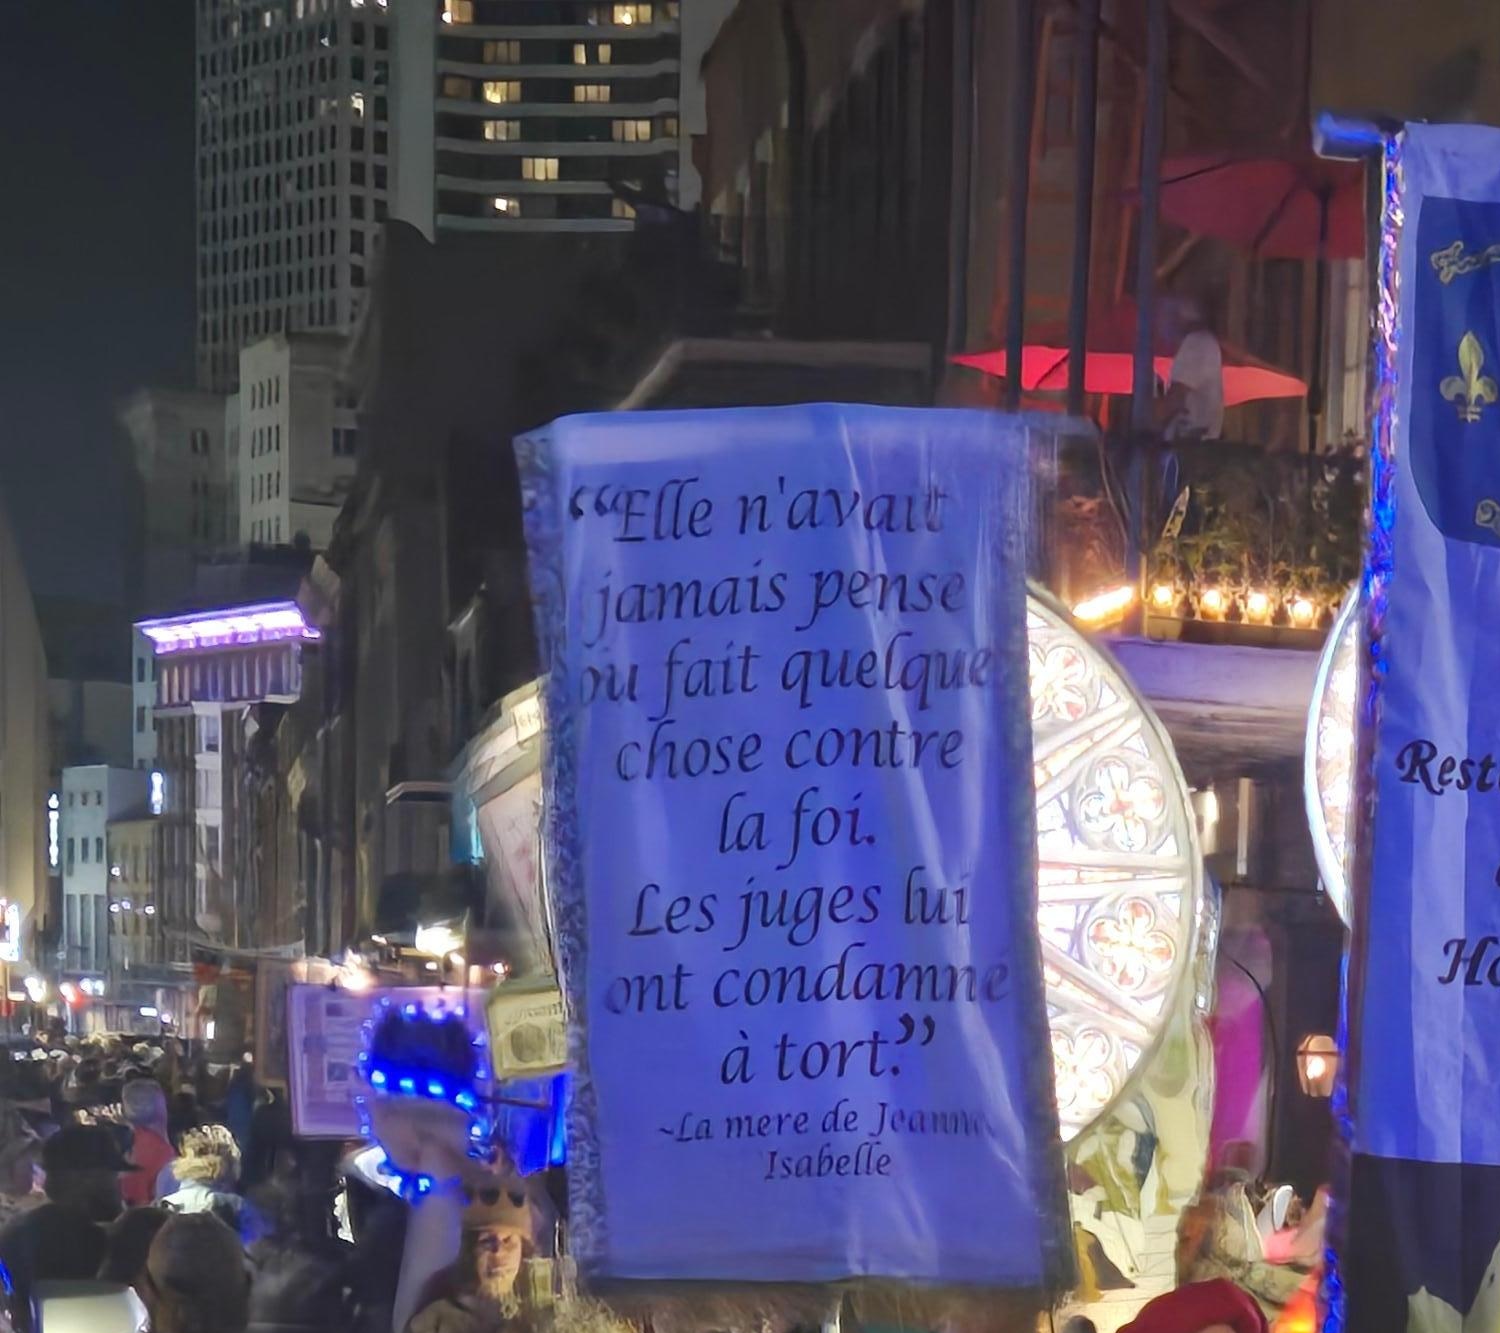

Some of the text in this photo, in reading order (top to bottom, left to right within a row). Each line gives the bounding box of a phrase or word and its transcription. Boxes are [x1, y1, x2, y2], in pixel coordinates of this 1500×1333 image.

[569, 476, 948, 542] “Elle n'avait
[583, 559, 965, 647] jamais pense
[579, 632, 993, 721] ou fait quelque
[617, 719, 964, 781] chose contre
[718, 787, 876, 869] la foi.
[628, 867, 970, 951] Les juges lui
[605, 961, 693, 1015] ont
[720, 1013, 936, 1085] à tort.”
[725, 1111, 808, 1140] mere
[821, 1098, 858, 1134] de
[764, 1142, 893, 1181] Isabelle
